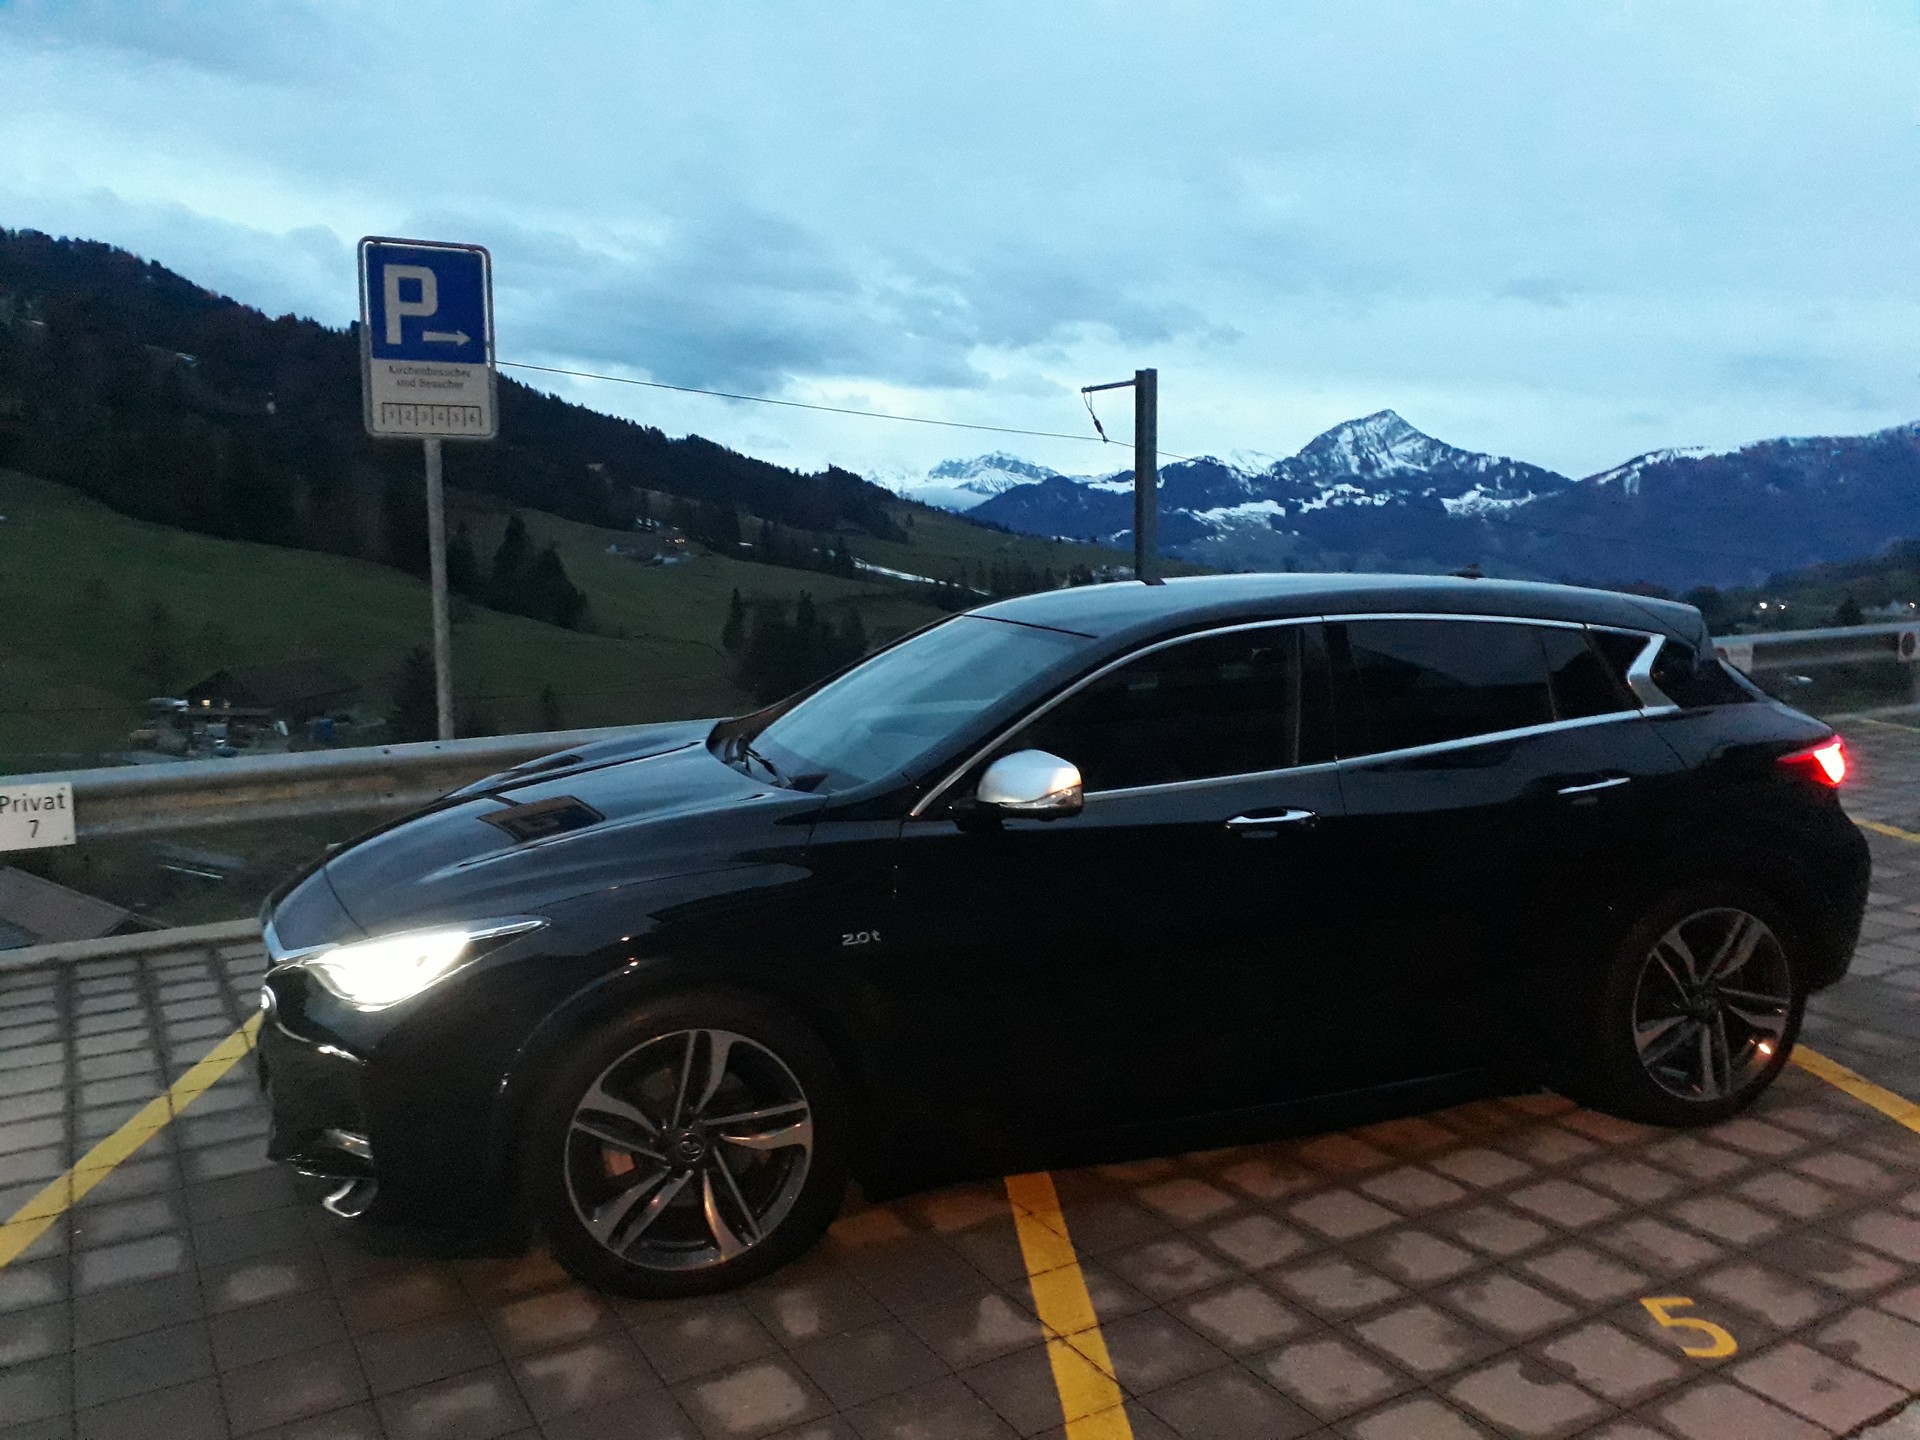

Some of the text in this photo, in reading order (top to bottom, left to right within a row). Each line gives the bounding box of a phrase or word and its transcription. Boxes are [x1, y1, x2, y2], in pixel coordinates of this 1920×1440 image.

[383, 264, 438, 345] P
[419, 379, 464, 389] Besucher
[0, 793, 66, 813] Privat
[28, 819, 39, 838] 7
[1639, 1296, 1738, 1358] 5
